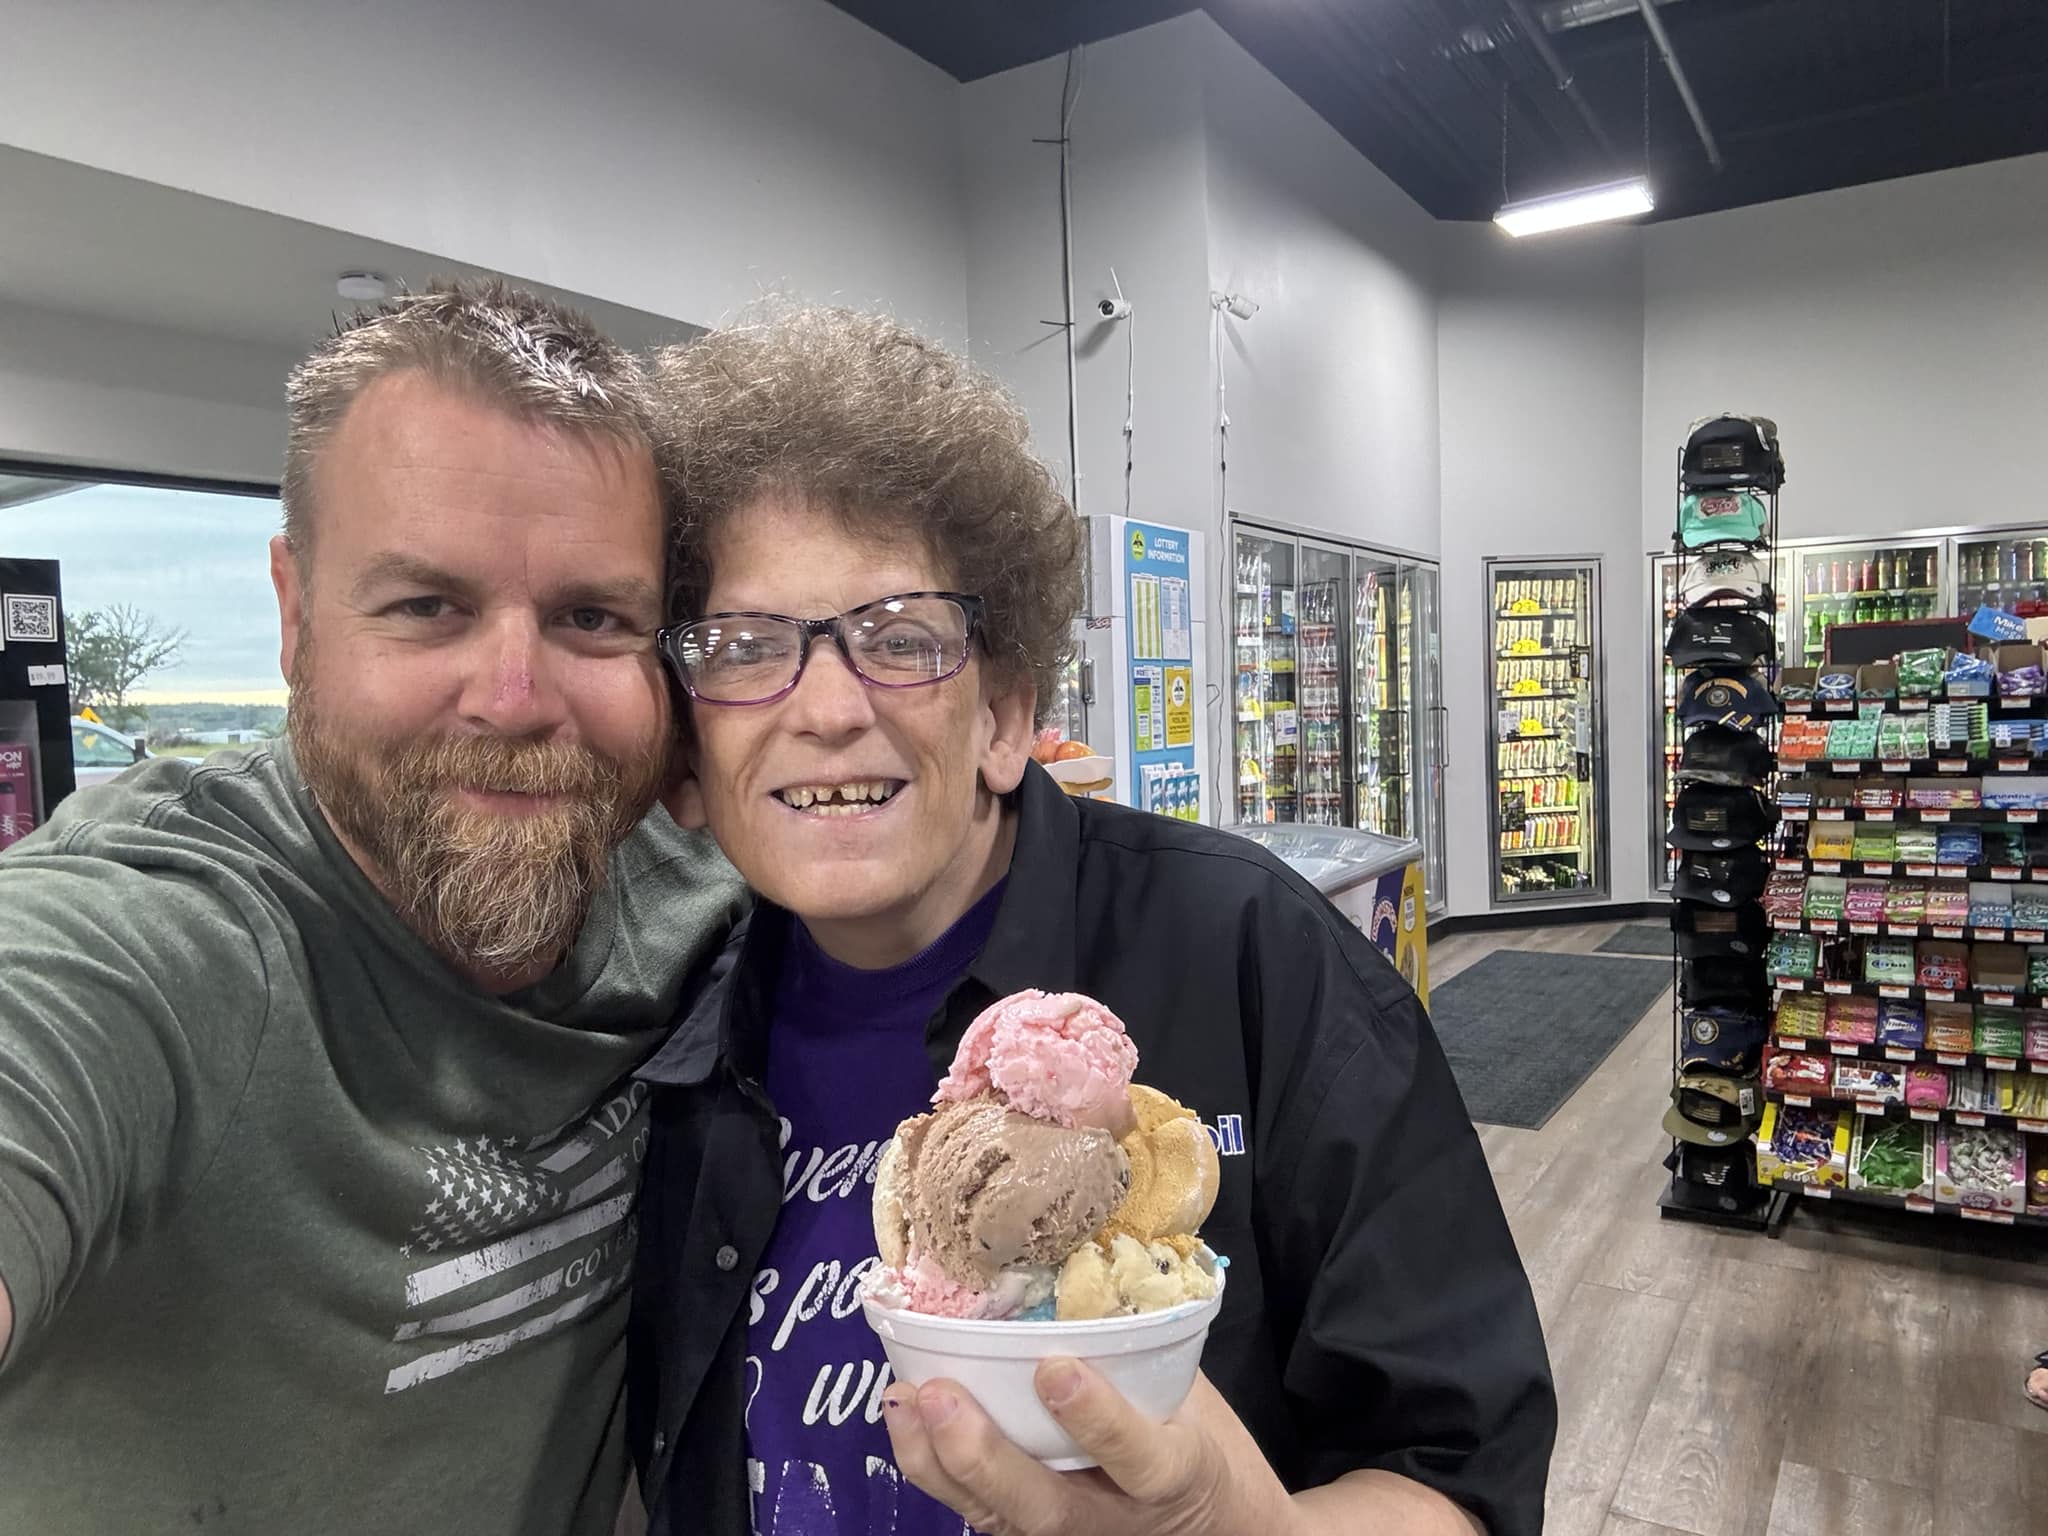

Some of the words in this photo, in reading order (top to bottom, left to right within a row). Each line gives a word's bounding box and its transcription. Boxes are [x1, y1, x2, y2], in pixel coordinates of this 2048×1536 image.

[1154, 536, 1179, 551] LOTTERY
[1147, 549, 1185, 564] INFORMATION
[1993, 615, 2024, 632] Mike
[0, 751, 22, 762] ON
[1768, 887, 1803, 896] Extra
[1887, 898, 1924, 908] Extra
[1930, 894, 1968, 904] Extra
[1846, 900, 1883, 910] Extra
